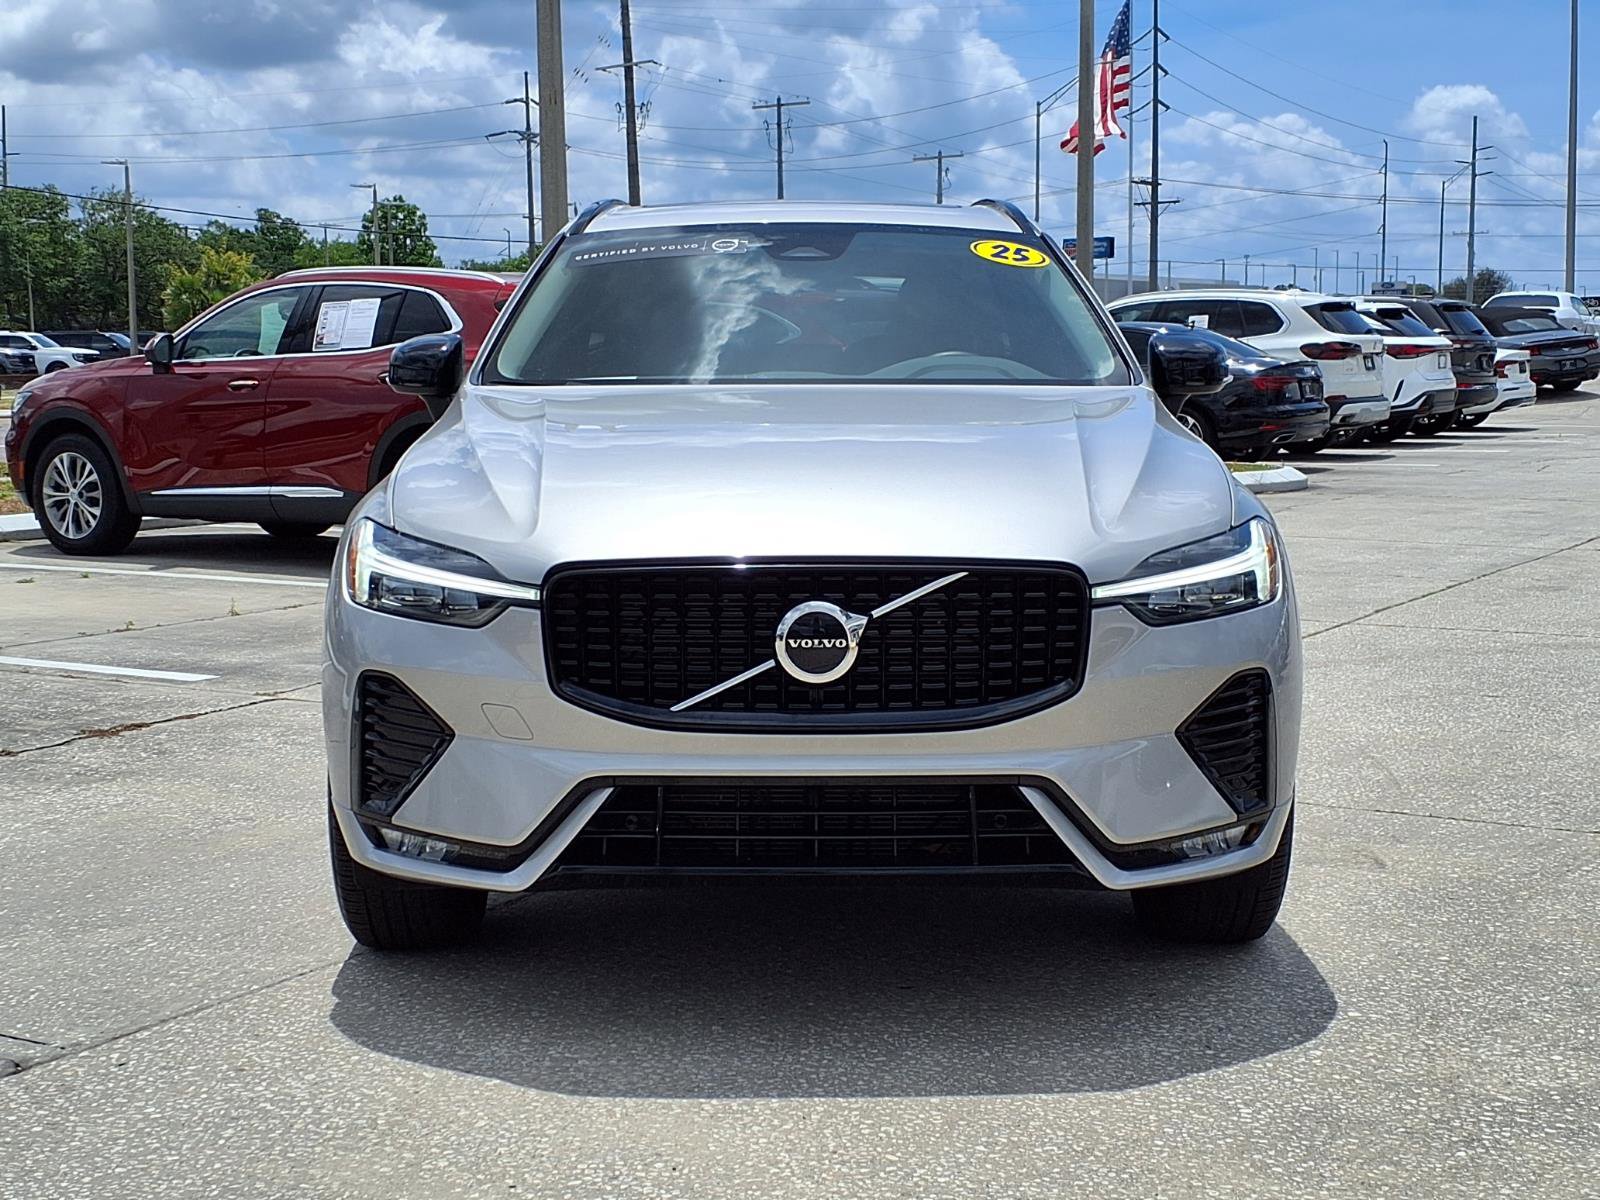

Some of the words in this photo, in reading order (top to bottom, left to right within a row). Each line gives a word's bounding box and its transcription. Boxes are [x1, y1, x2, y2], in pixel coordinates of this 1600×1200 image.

[575, 249, 637, 261] CERTIFIED
[990, 244, 1030, 262] 25
[787, 639, 847, 649] VOLVO
